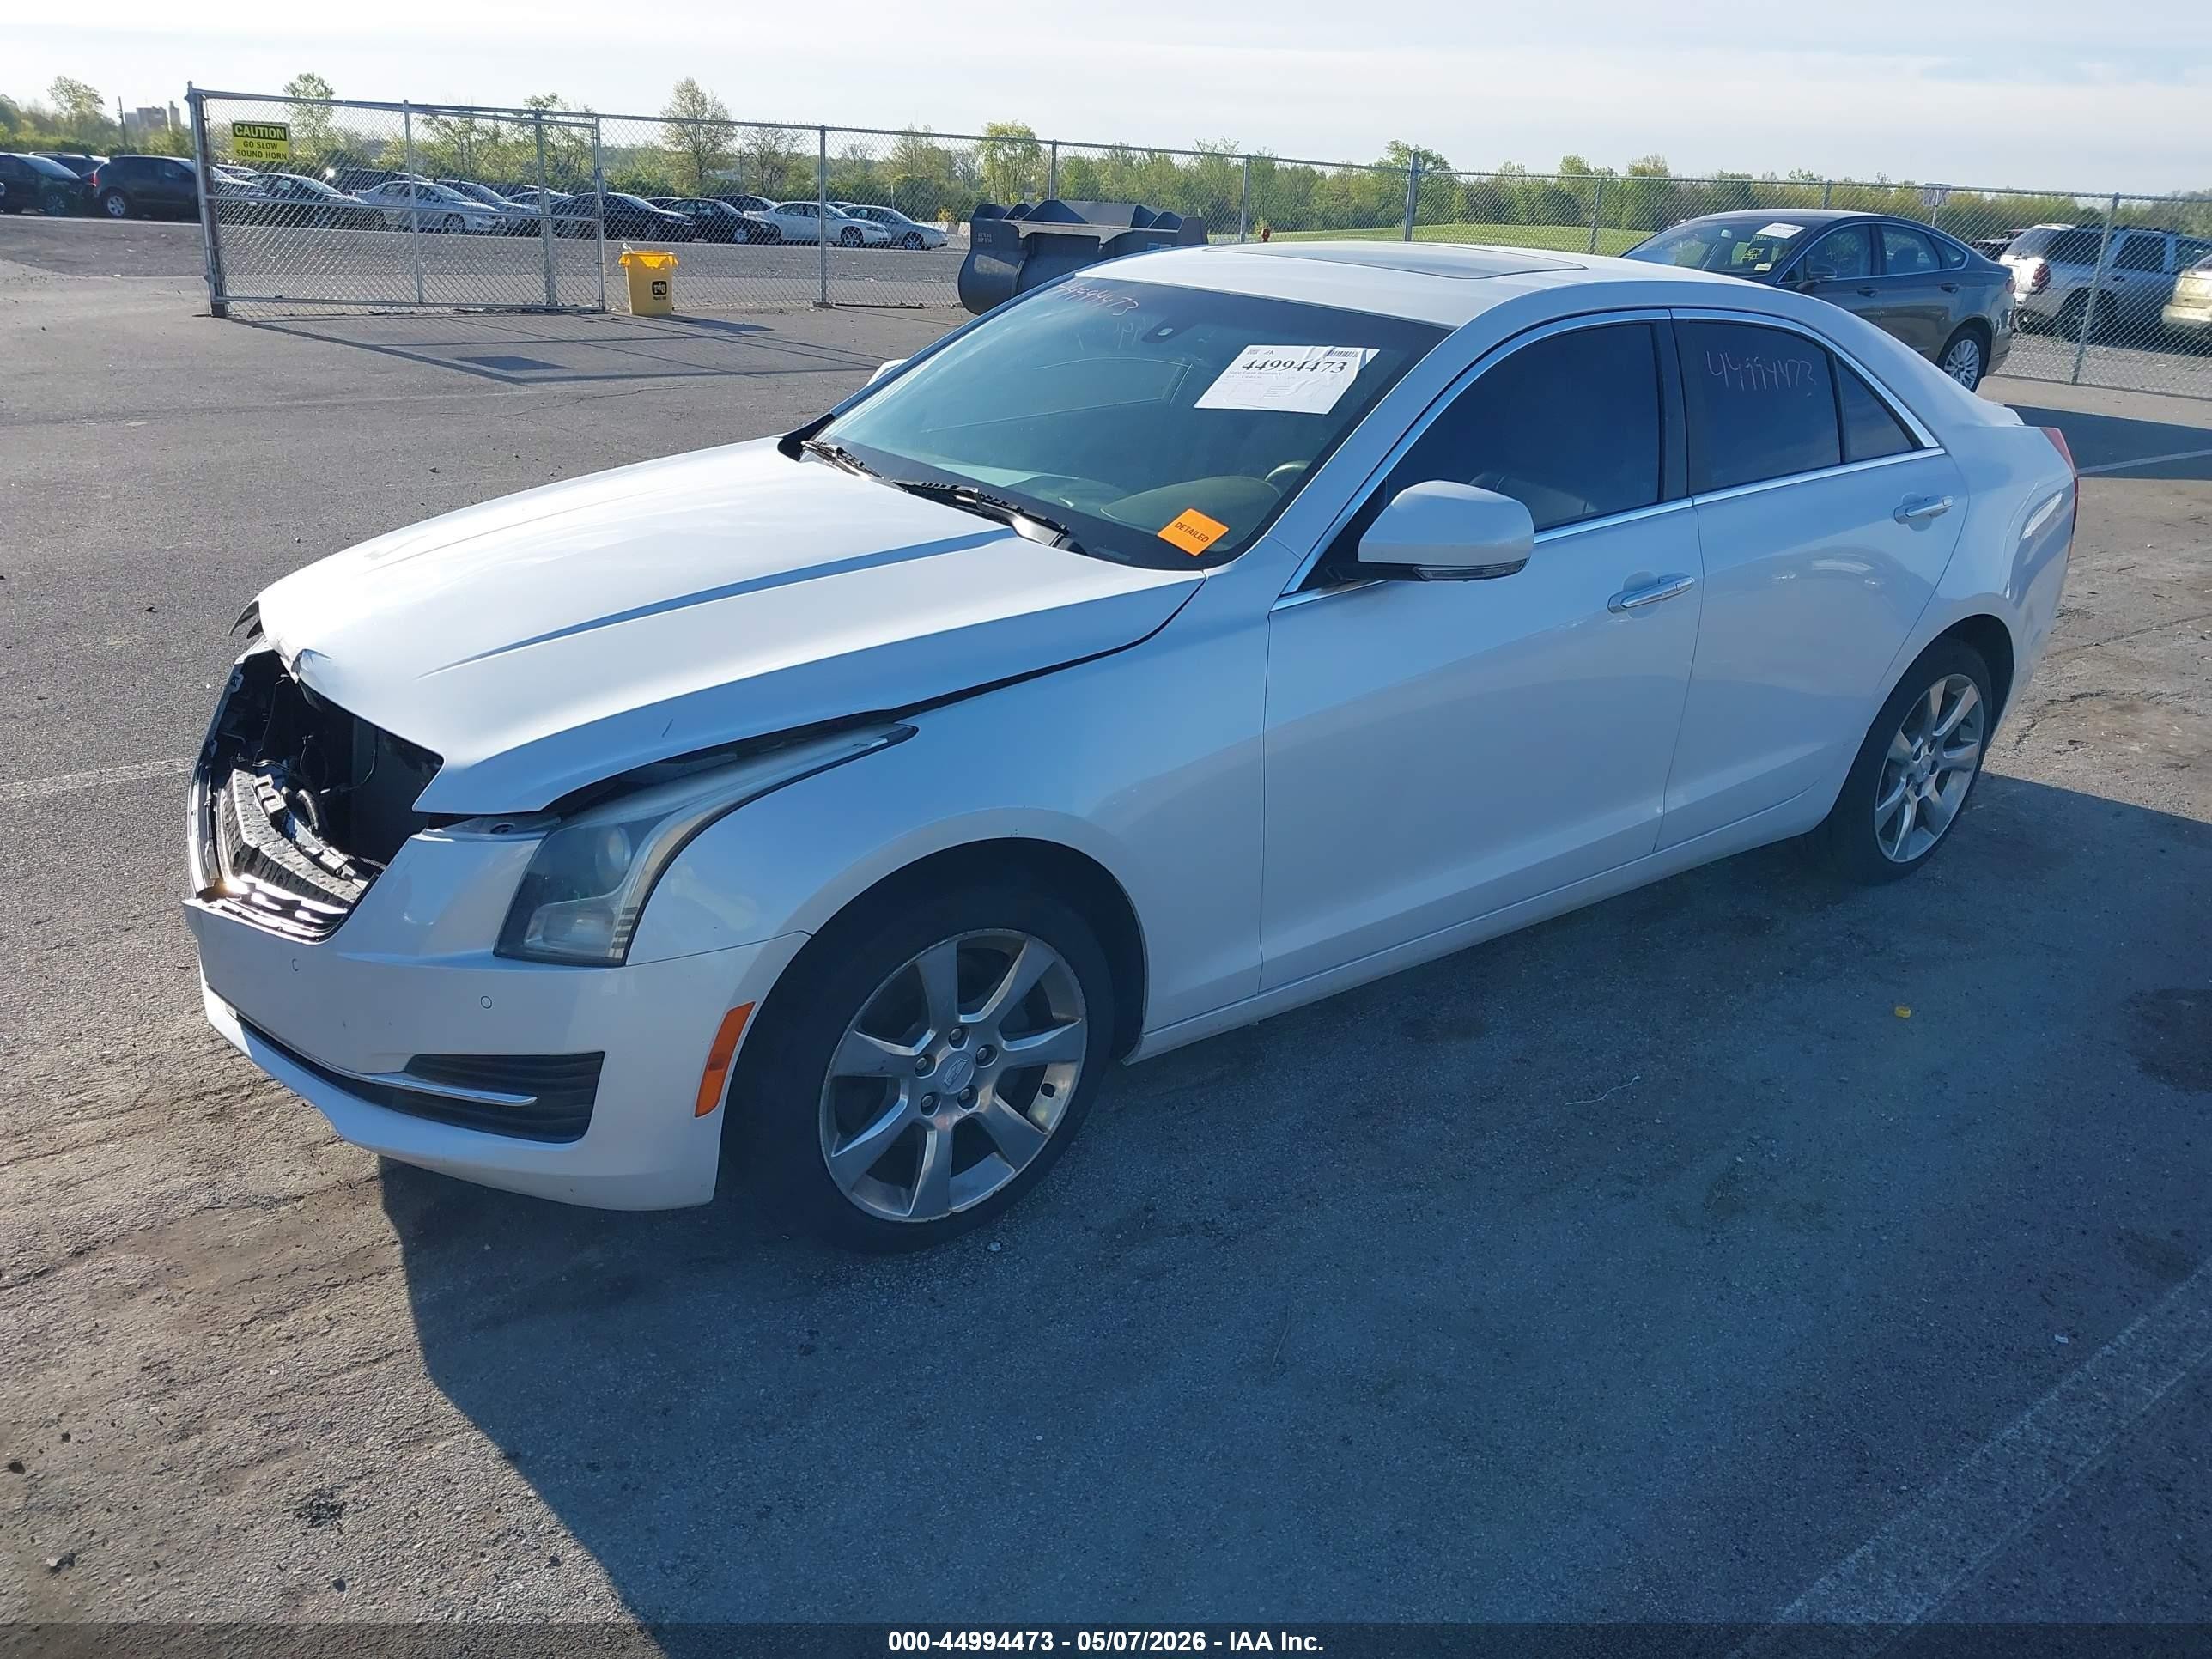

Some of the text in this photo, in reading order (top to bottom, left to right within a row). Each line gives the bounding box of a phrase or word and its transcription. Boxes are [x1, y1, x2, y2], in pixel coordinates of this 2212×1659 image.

[234, 125, 285, 139] CAUTION
[243, 140, 278, 150] GO SLOW
[236, 149, 288, 161] SOUND HORN
[1242, 359, 1347, 374] 44994473
[1174, 521, 1210, 543] DETAILED
